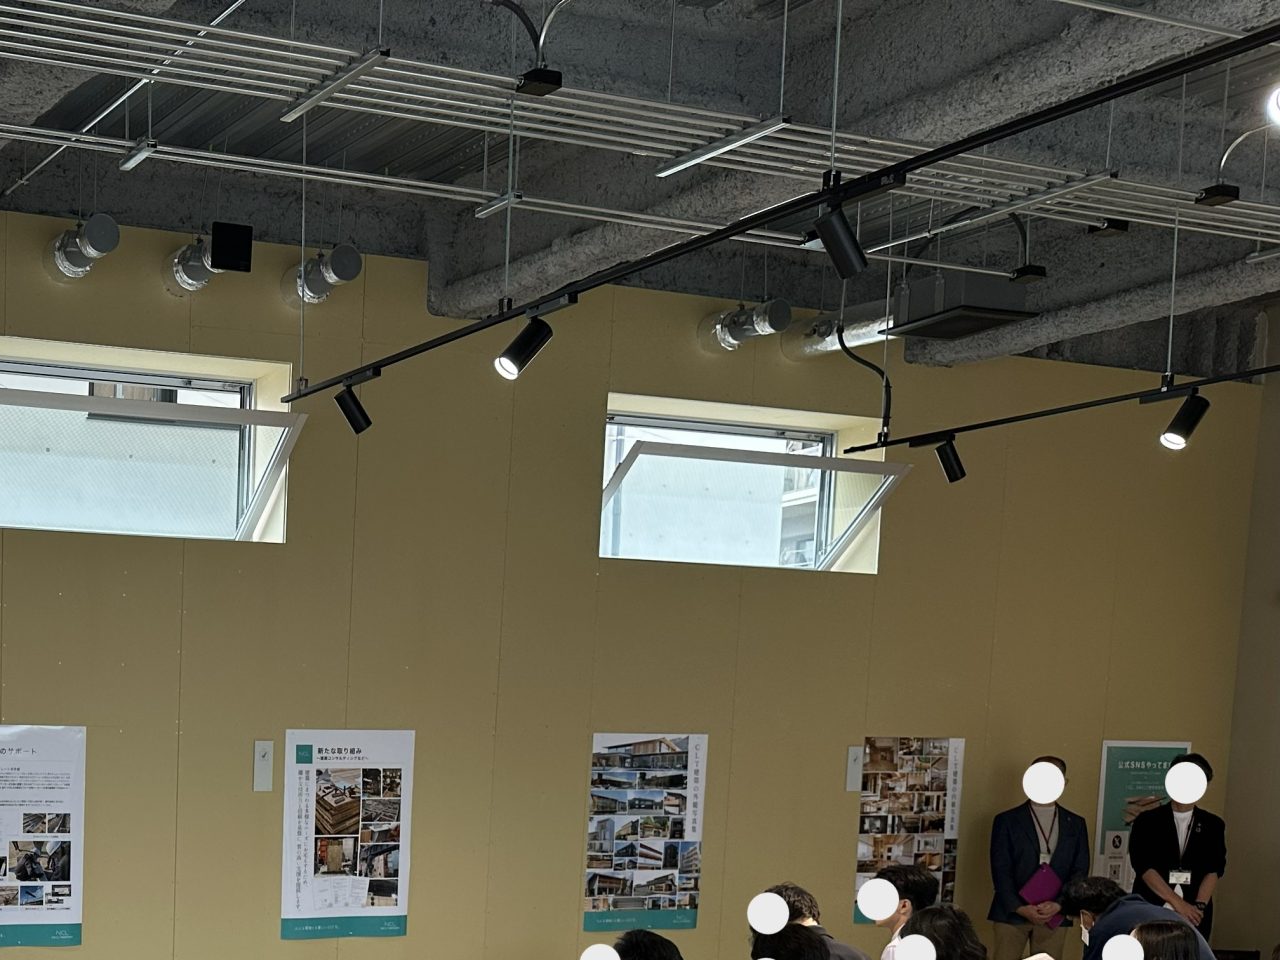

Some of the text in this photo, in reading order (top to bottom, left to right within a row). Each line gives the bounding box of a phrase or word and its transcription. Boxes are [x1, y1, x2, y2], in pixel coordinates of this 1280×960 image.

[317, 747, 362, 755] 新たな取り組み
